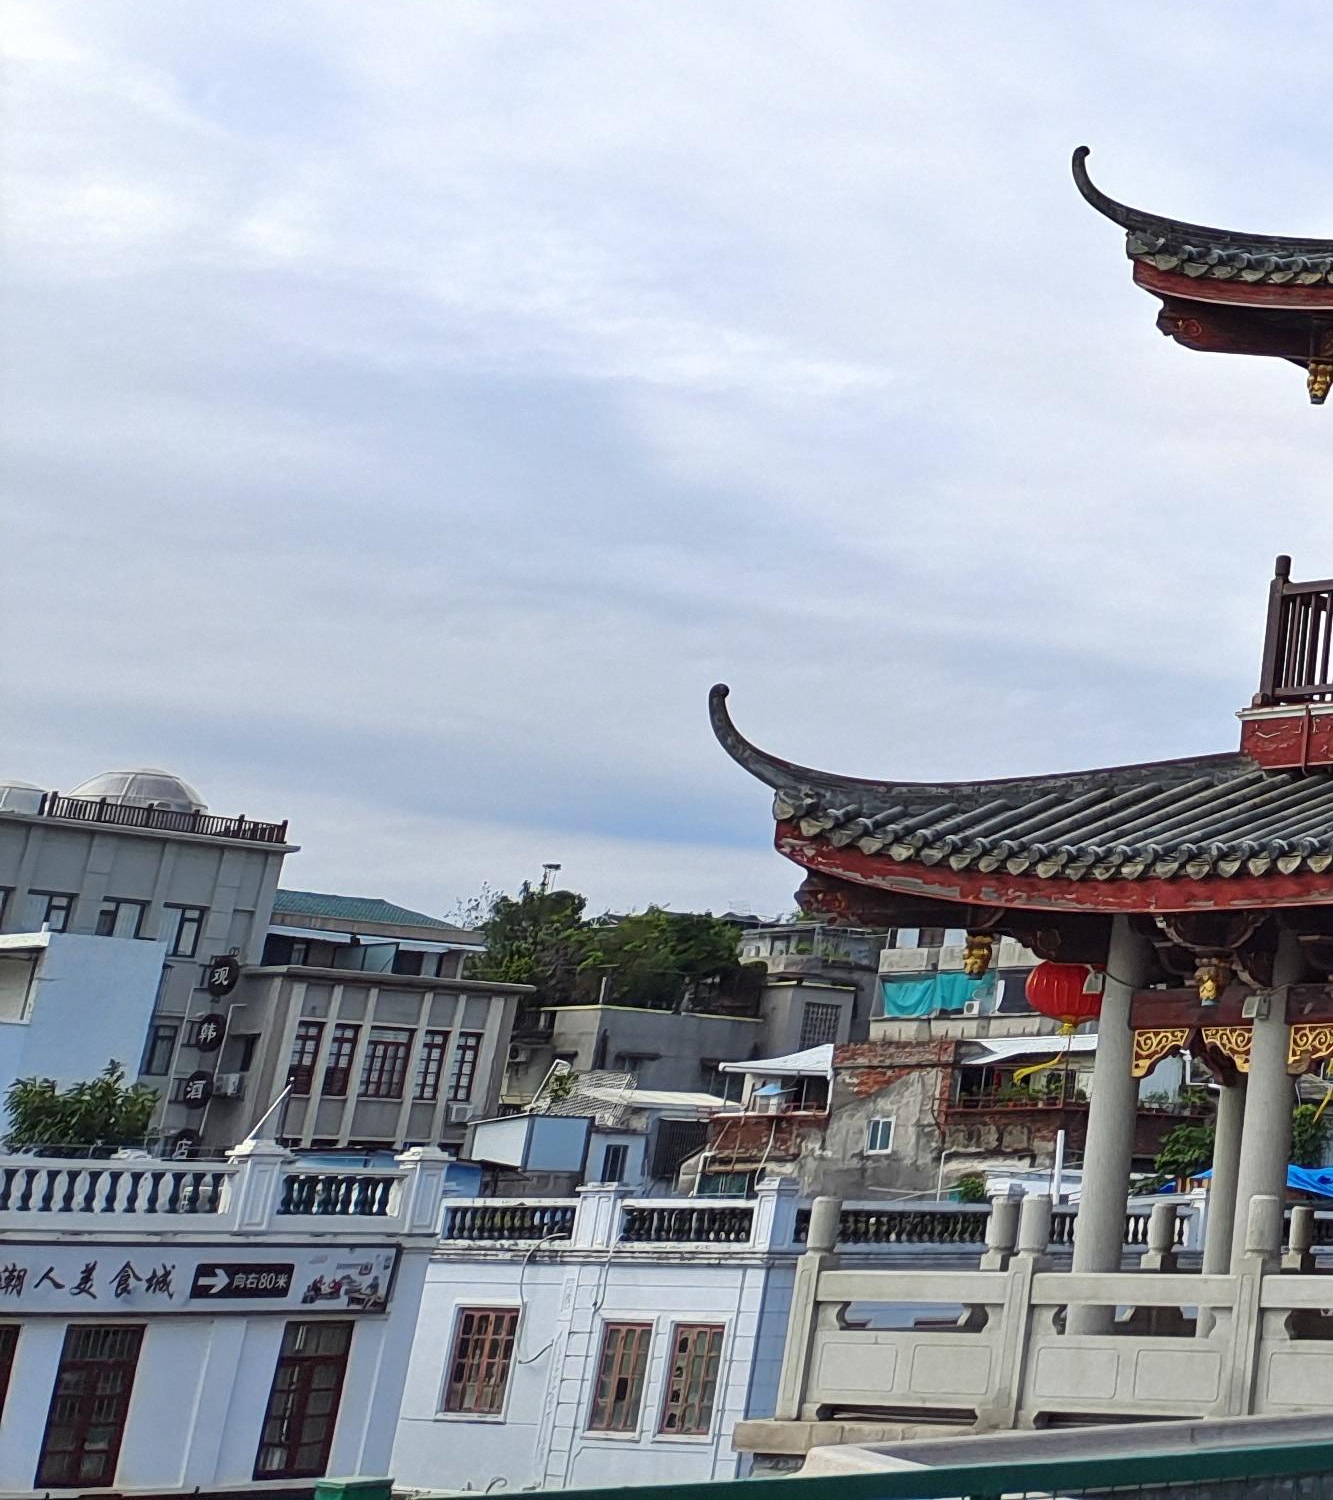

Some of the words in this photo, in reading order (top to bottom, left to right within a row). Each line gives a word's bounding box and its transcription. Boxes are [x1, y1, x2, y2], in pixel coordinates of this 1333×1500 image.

[173, 965, 229, 1160] 观韩酒店
[231, 1271, 288, 1290] 向右80米
